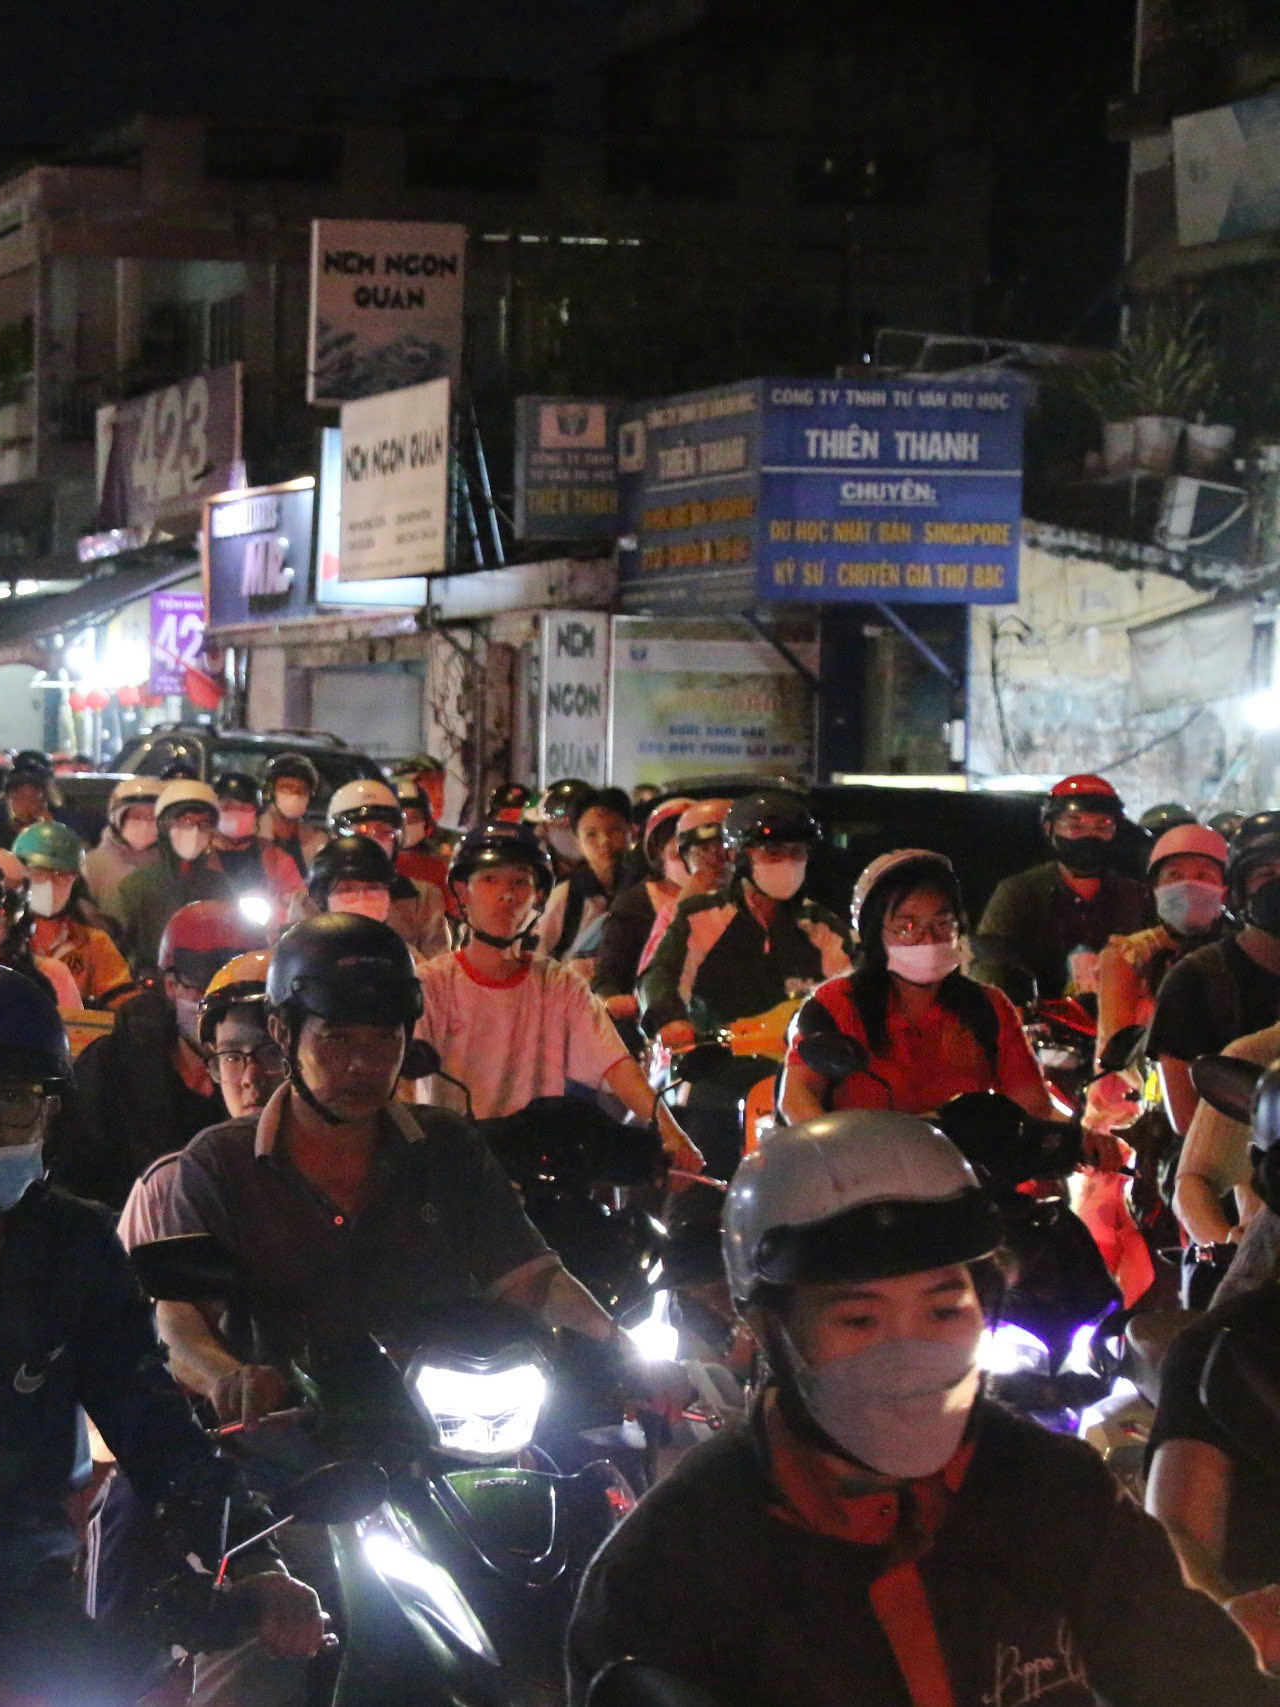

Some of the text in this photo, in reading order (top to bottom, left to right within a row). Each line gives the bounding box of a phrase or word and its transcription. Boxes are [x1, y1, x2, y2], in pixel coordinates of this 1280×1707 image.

[819, 388, 839, 406] TY
[845, 388, 887, 407] TNHH
[131, 377, 209, 502] 423
[805, 423, 980, 462] THIÊN THANH
